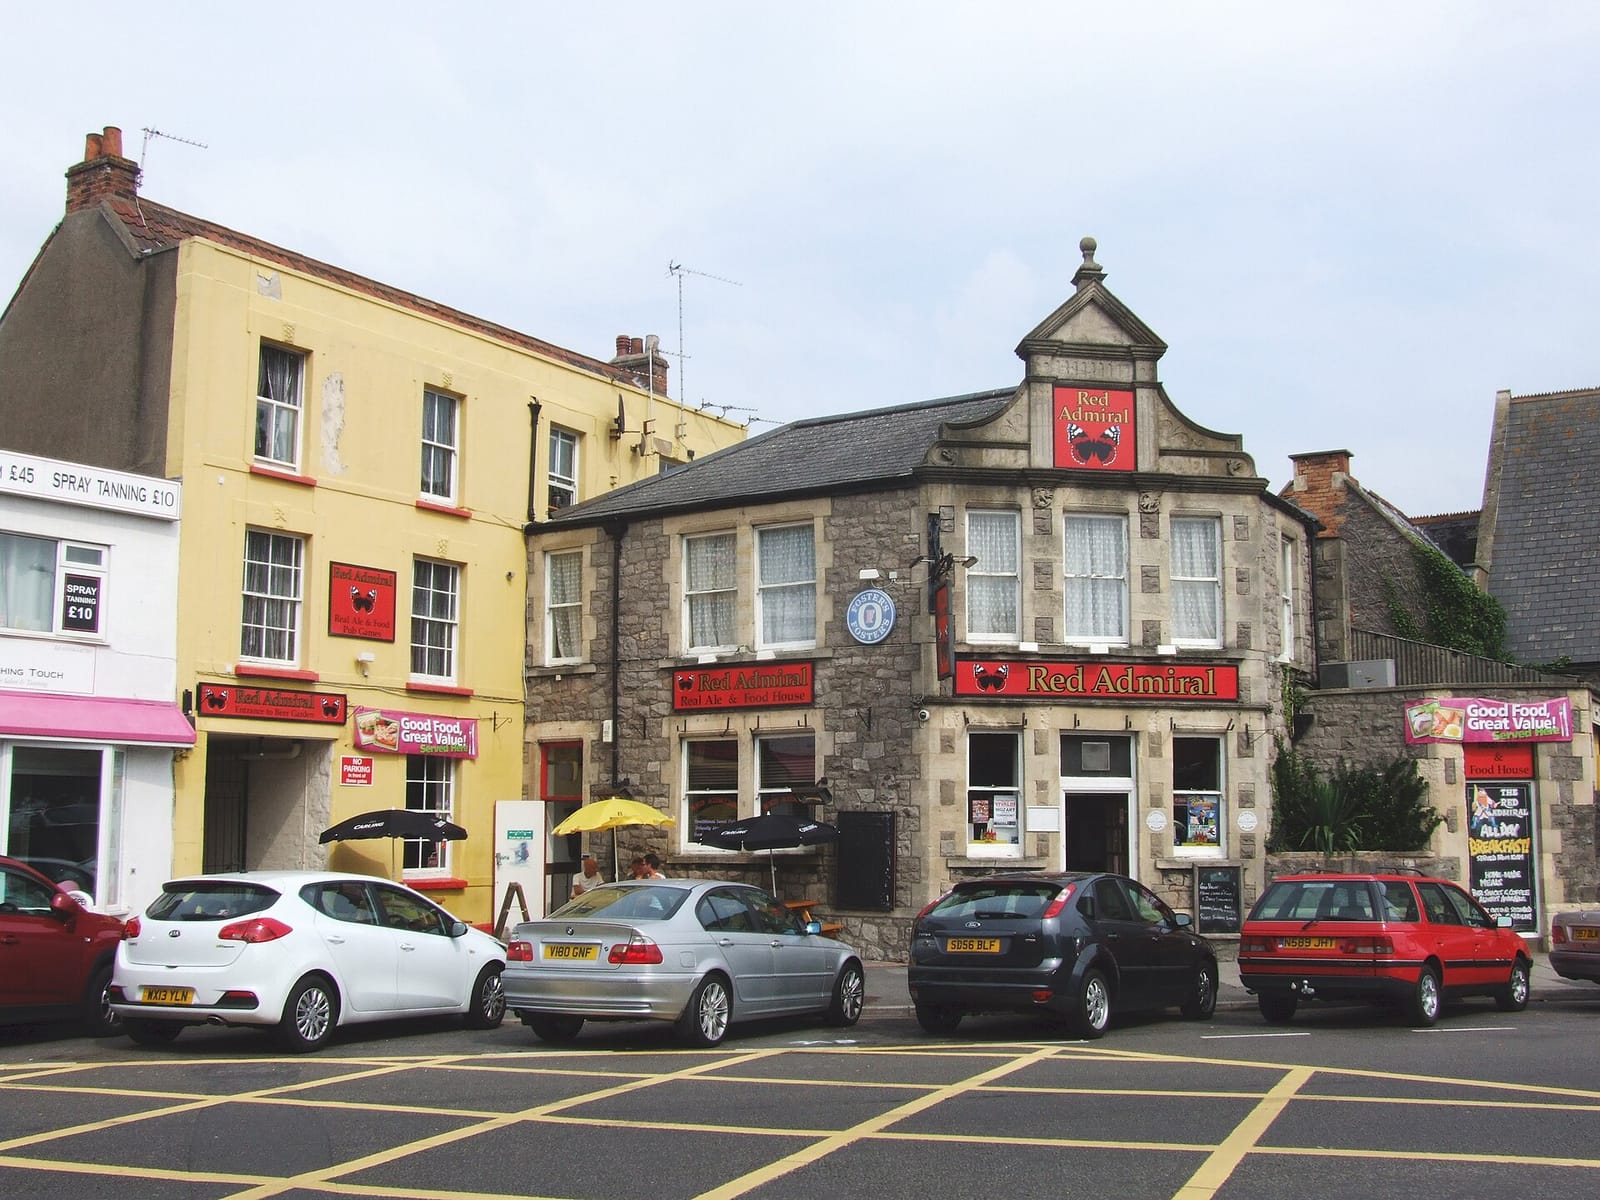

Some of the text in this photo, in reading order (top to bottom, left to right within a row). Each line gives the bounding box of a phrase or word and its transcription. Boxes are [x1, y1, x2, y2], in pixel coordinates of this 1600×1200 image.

[1077, 391, 1109, 406] Red
[1059, 406, 1129, 424] Admiral
[9, 465, 34, 483] £45
[53, 472, 174, 507] SPRAY TANNING £10
[333, 567, 393, 587] Red Admiral
[66, 584, 97, 595] SPRAY
[66, 595, 97, 605] TANNING
[851, 592, 890, 613] FOSTER'S
[68, 606, 93, 620] £10
[335, 614, 350, 624] Real
[353, 617, 363, 625] Ale
[373, 619, 390, 629] Food
[851, 618, 890, 641] FOSTER'S
[698, 667, 808, 691] Red Admiral
[1027, 666, 1216, 696] Red Admiral
[234, 689, 315, 709] Red Admiral
[681, 695, 701, 706] Real
[705, 694, 722, 705] Ale
[744, 692, 768, 704] Food
[773, 690, 805, 702] House
[1467, 704, 1550, 718] Good Food,
[401, 717, 463, 735] Good Food,
[1467, 717, 1556, 730] Great Value!
[401, 730, 467, 747] Great Value!
[1493, 726, 1560, 740] Served Here
[420, 743, 448, 754] Served
[1494, 753, 1503, 762] &
[343, 765, 371, 773] PARKING
[1470, 764, 1529, 774] Food House
[1500, 788, 1518, 797] THE
[1500, 798, 1519, 808] RED
[1480, 823, 1500, 838] ALL
[1469, 837, 1530, 857] BREAKFAST!
[572, 947, 592, 958] GNF
[950, 940, 996, 950] SD56 BLF
[169, 991, 189, 1002] YLN
